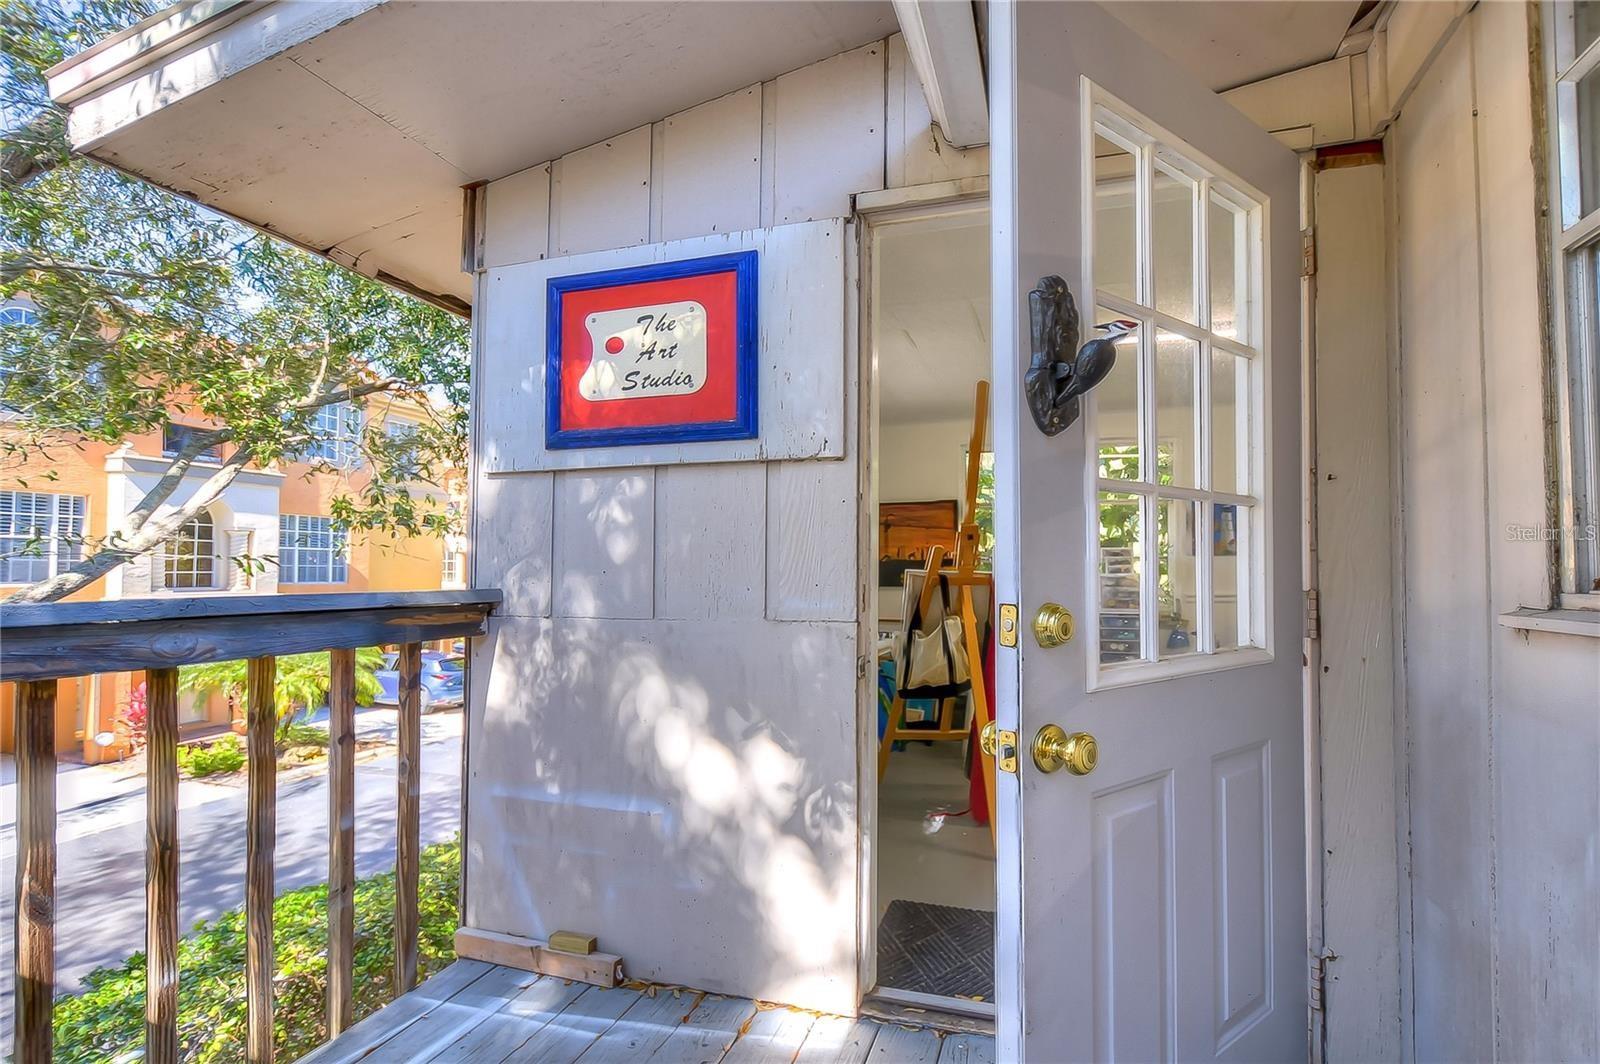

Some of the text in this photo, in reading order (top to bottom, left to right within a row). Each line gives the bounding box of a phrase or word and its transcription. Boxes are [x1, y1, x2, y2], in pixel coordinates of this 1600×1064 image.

[637, 312, 677, 336] The
[635, 340, 679, 364] Art
[621, 369, 694, 391] Studio
